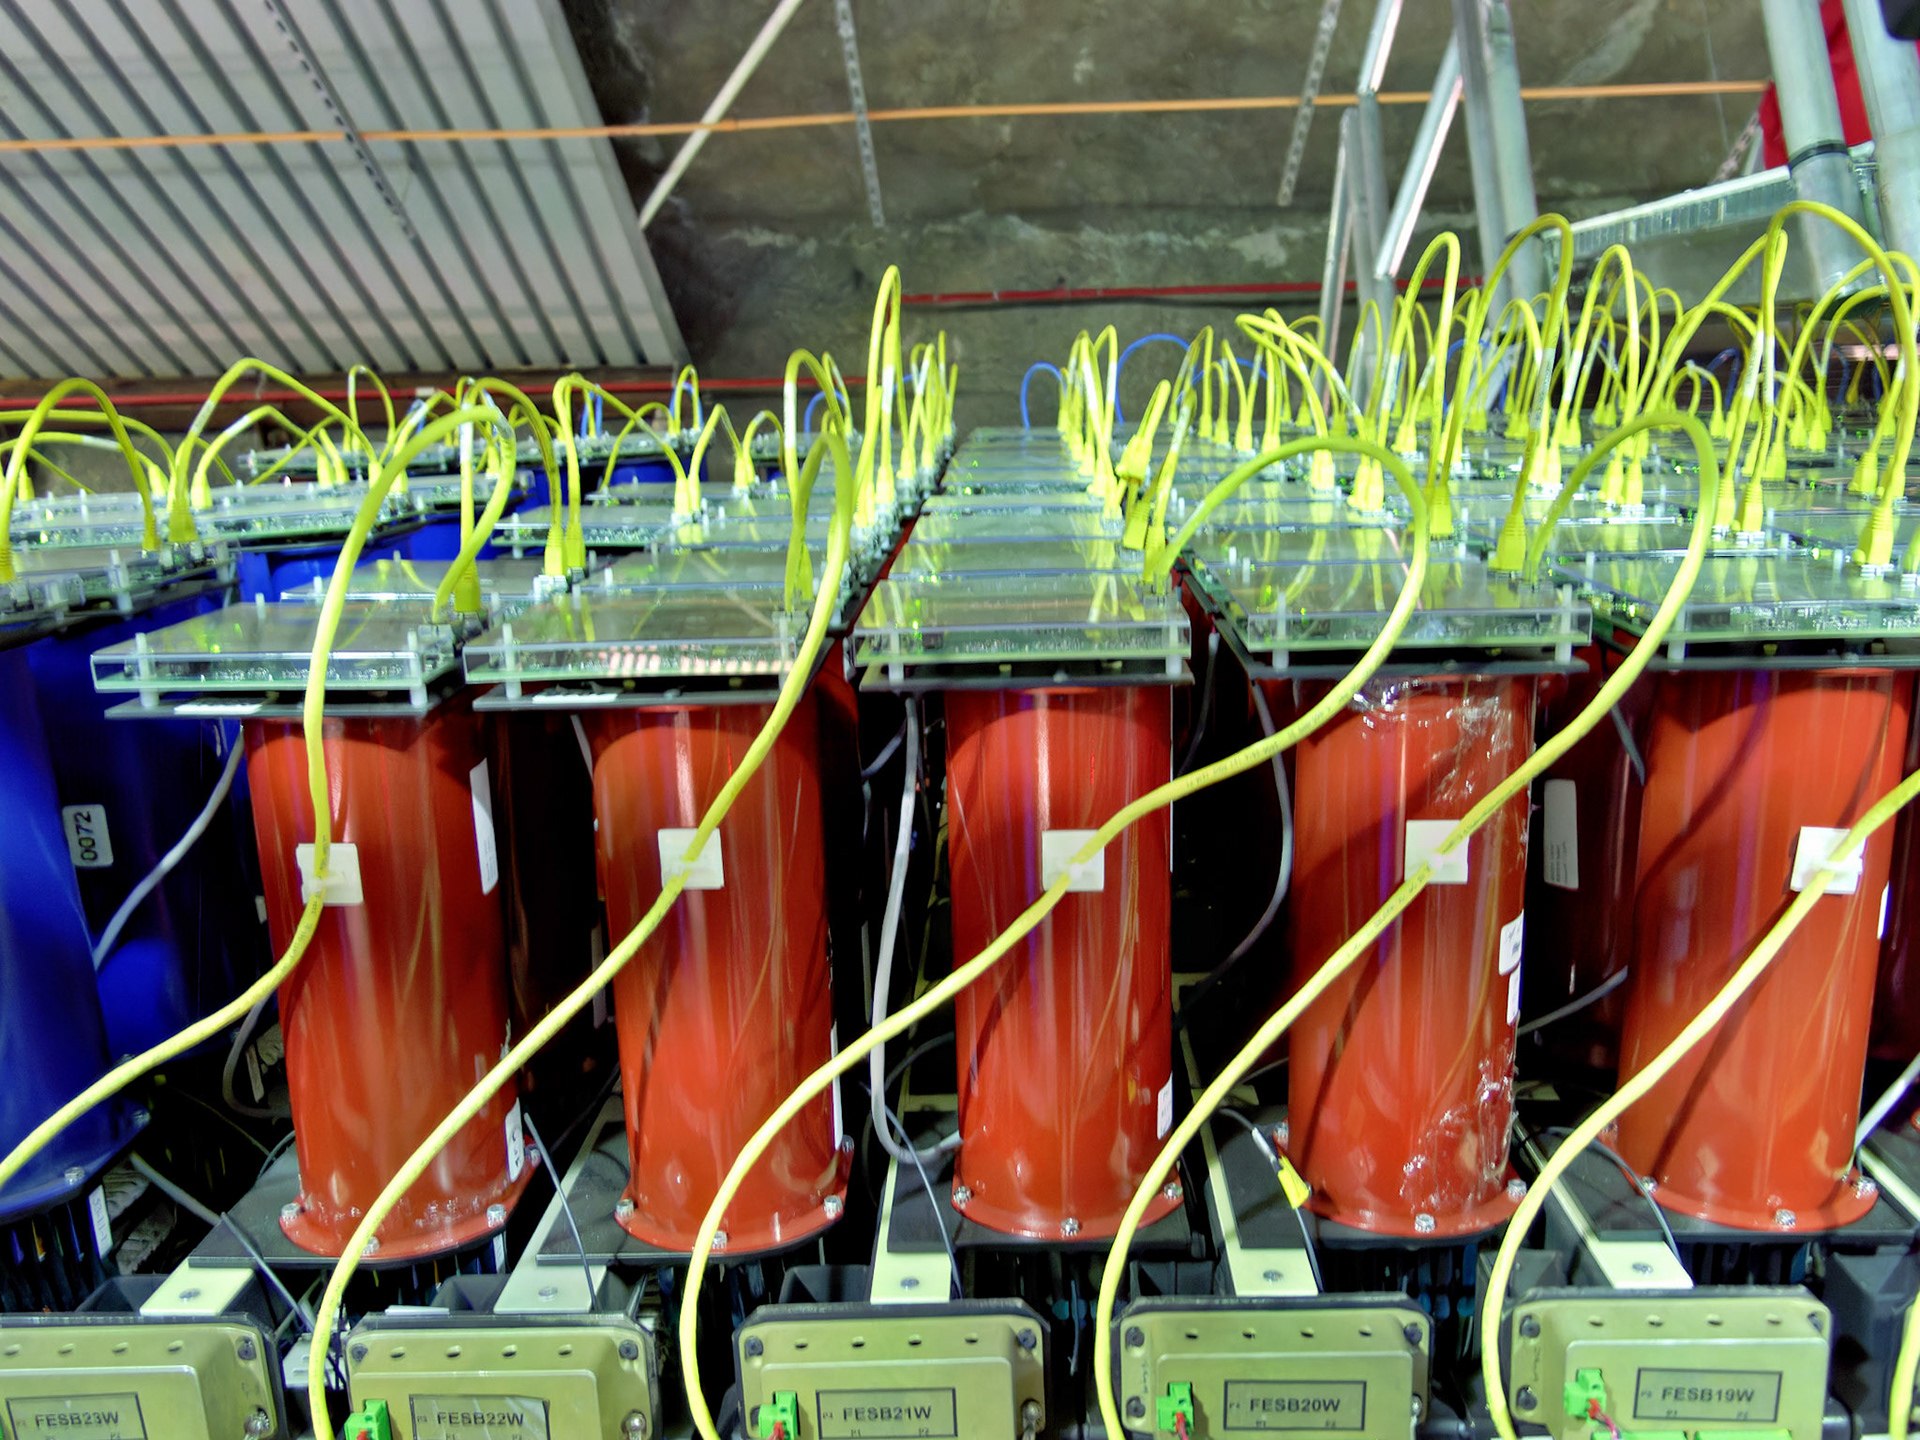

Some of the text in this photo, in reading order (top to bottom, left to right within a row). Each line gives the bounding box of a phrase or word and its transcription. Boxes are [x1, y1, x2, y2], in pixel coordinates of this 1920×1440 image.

[73, 811, 98, 861] 0072
[1661, 1386, 1755, 1403] FESB19W
[843, 1405, 932, 1421] FESB21W
[1250, 1398, 1340, 1413] FESB20W
[34, 1411, 119, 1427] FESB23W
[437, 1411, 524, 1426] FESB22W
